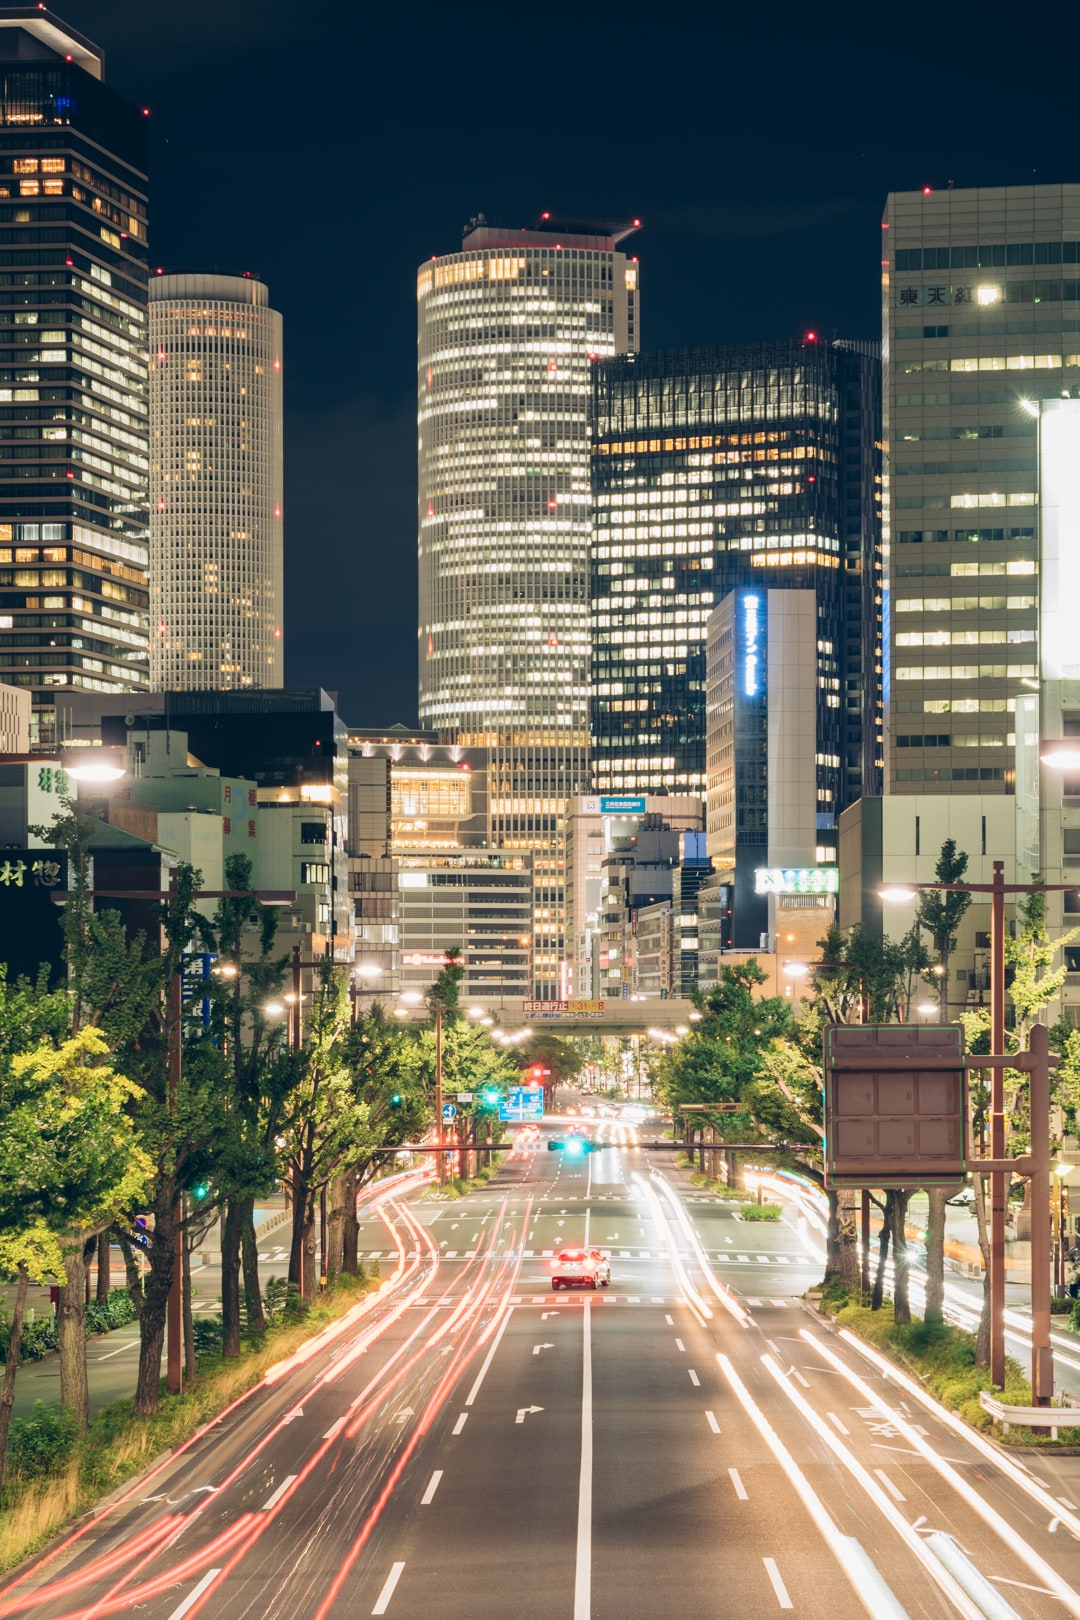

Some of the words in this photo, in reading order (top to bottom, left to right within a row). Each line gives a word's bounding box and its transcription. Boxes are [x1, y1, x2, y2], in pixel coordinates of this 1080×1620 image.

[900, 287, 973, 305] 東天紅
[231, 787, 248, 837] P
